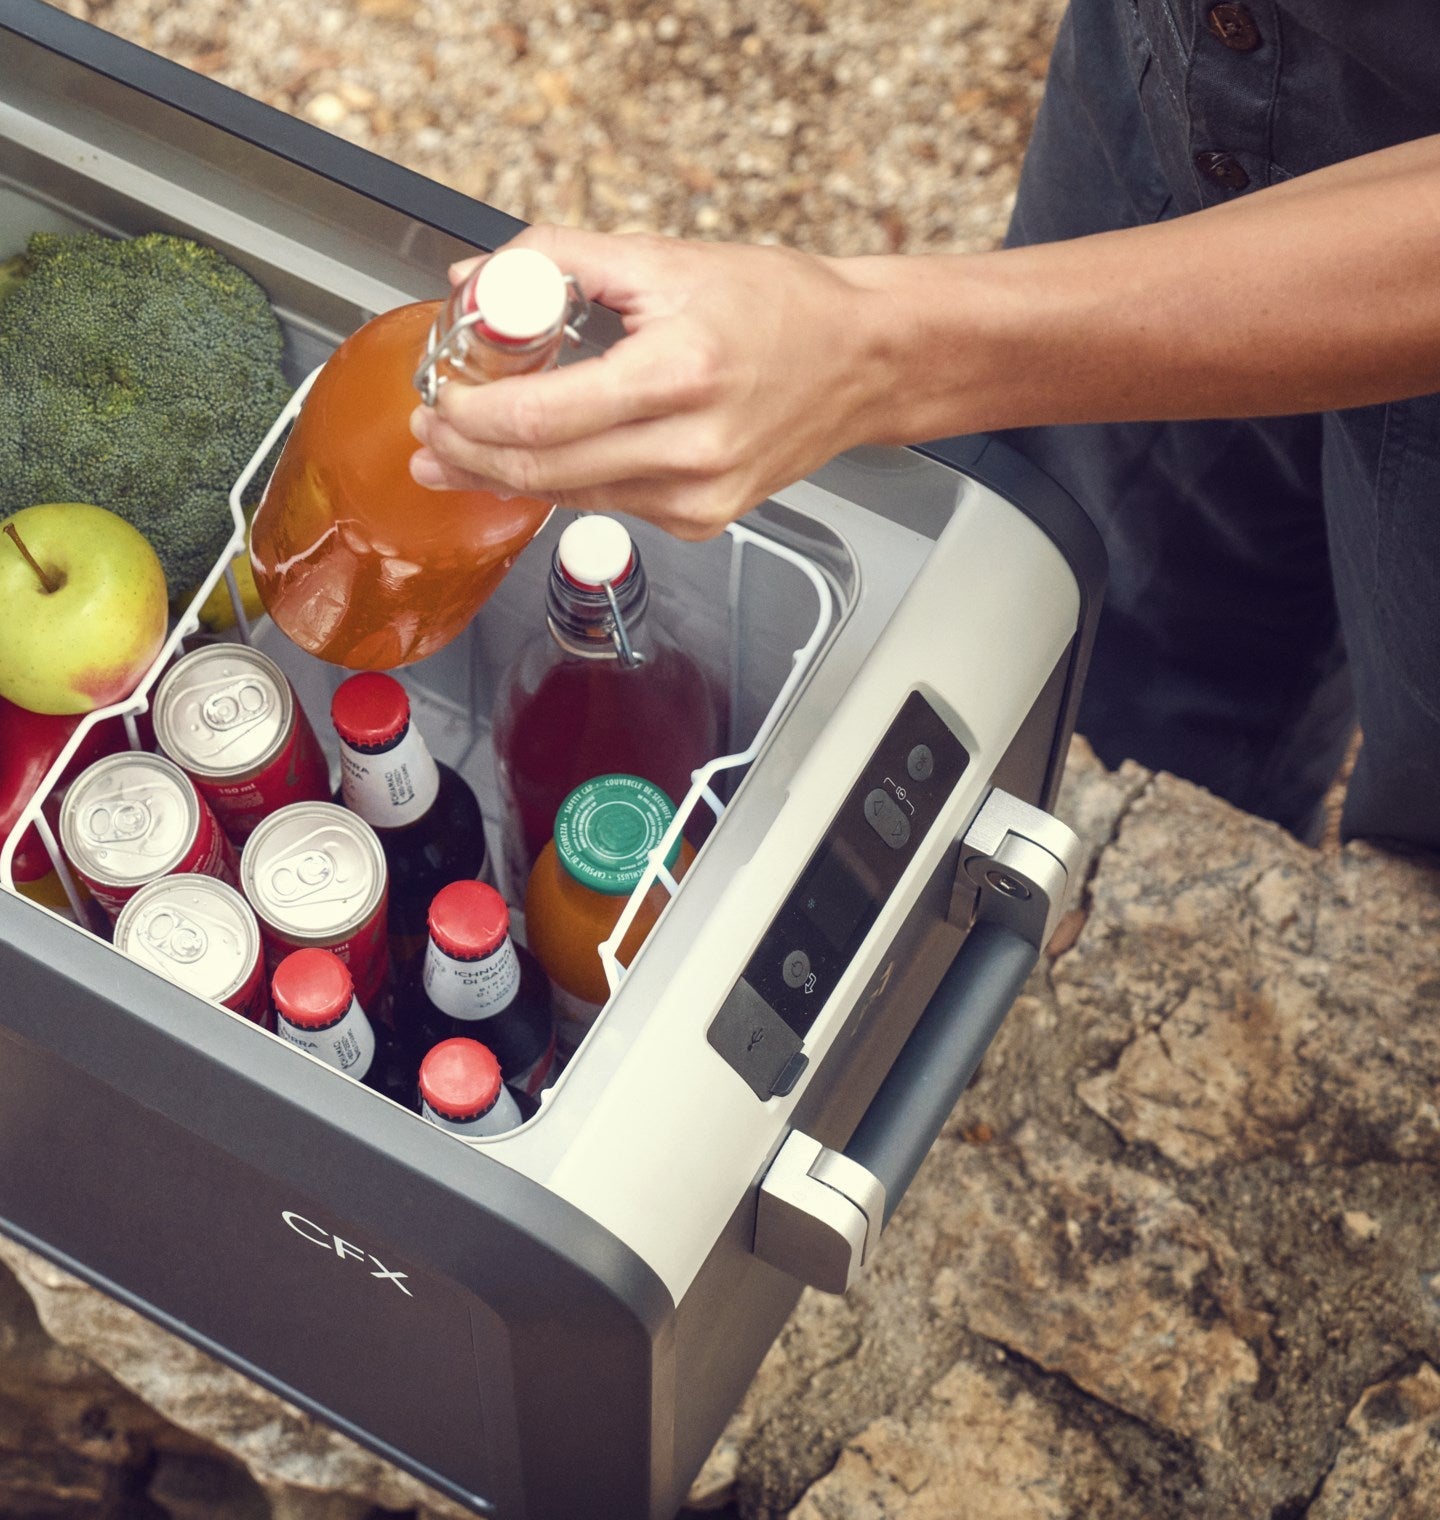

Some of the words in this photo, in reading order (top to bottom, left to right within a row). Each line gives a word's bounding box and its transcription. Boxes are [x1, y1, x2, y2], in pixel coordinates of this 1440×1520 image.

[240, 783, 256, 792] ml
[604, 778, 643, 790] COUVERCLE
[564, 793, 582, 814] SAFETY
[582, 784, 593, 795] CAP
[559, 822, 574, 857] SICUREZZA
[570, 854, 580, 865] DI
[577, 861, 606, 879] CAPSULA
[281, 1210, 414, 1298] CFX
